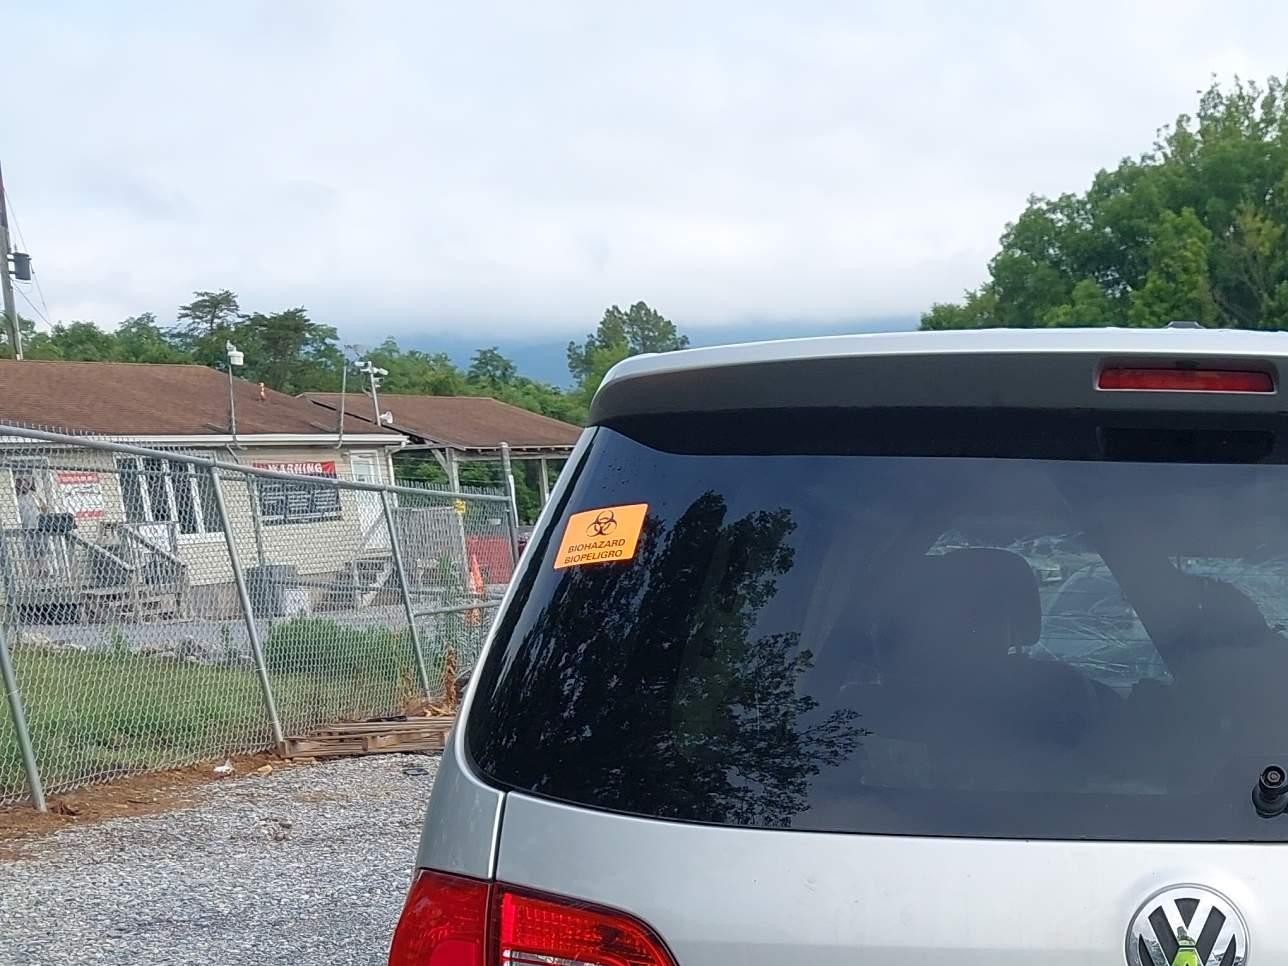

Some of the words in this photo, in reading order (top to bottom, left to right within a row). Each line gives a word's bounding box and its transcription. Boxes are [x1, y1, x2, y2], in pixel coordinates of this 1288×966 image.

[268, 463, 323, 475] WARNING
[568, 538, 626, 553] BIOHAZARD
[564, 551, 623, 564] BIOPELIGRO
